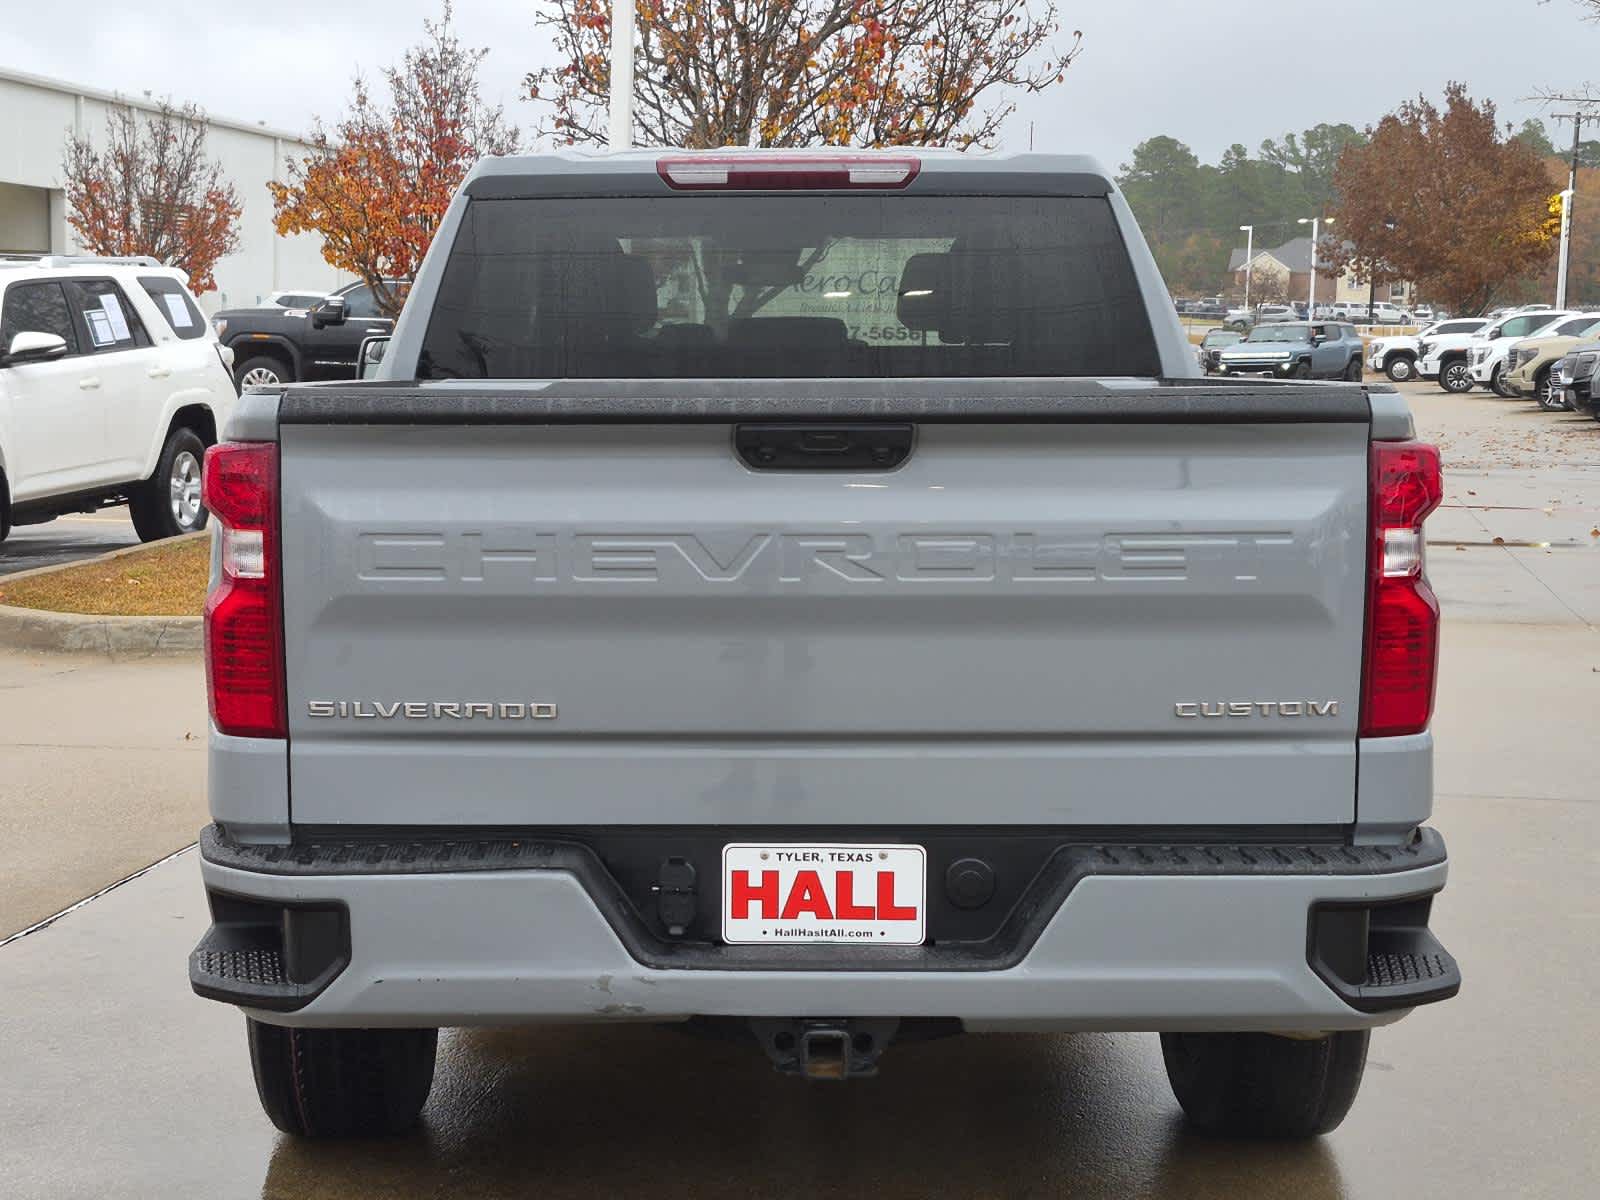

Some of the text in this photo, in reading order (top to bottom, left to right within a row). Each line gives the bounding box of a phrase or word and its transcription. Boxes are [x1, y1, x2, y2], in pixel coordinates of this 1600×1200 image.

[359, 532, 1294, 584] CHEVROLET
[308, 700, 557, 719] SILVERADO
[1174, 701, 1338, 718] CUSTOM
[775, 852, 873, 863] TYLER, TEXAS
[731, 869, 918, 921] HALL
[774, 927, 873, 938] HallHasItAll.com
